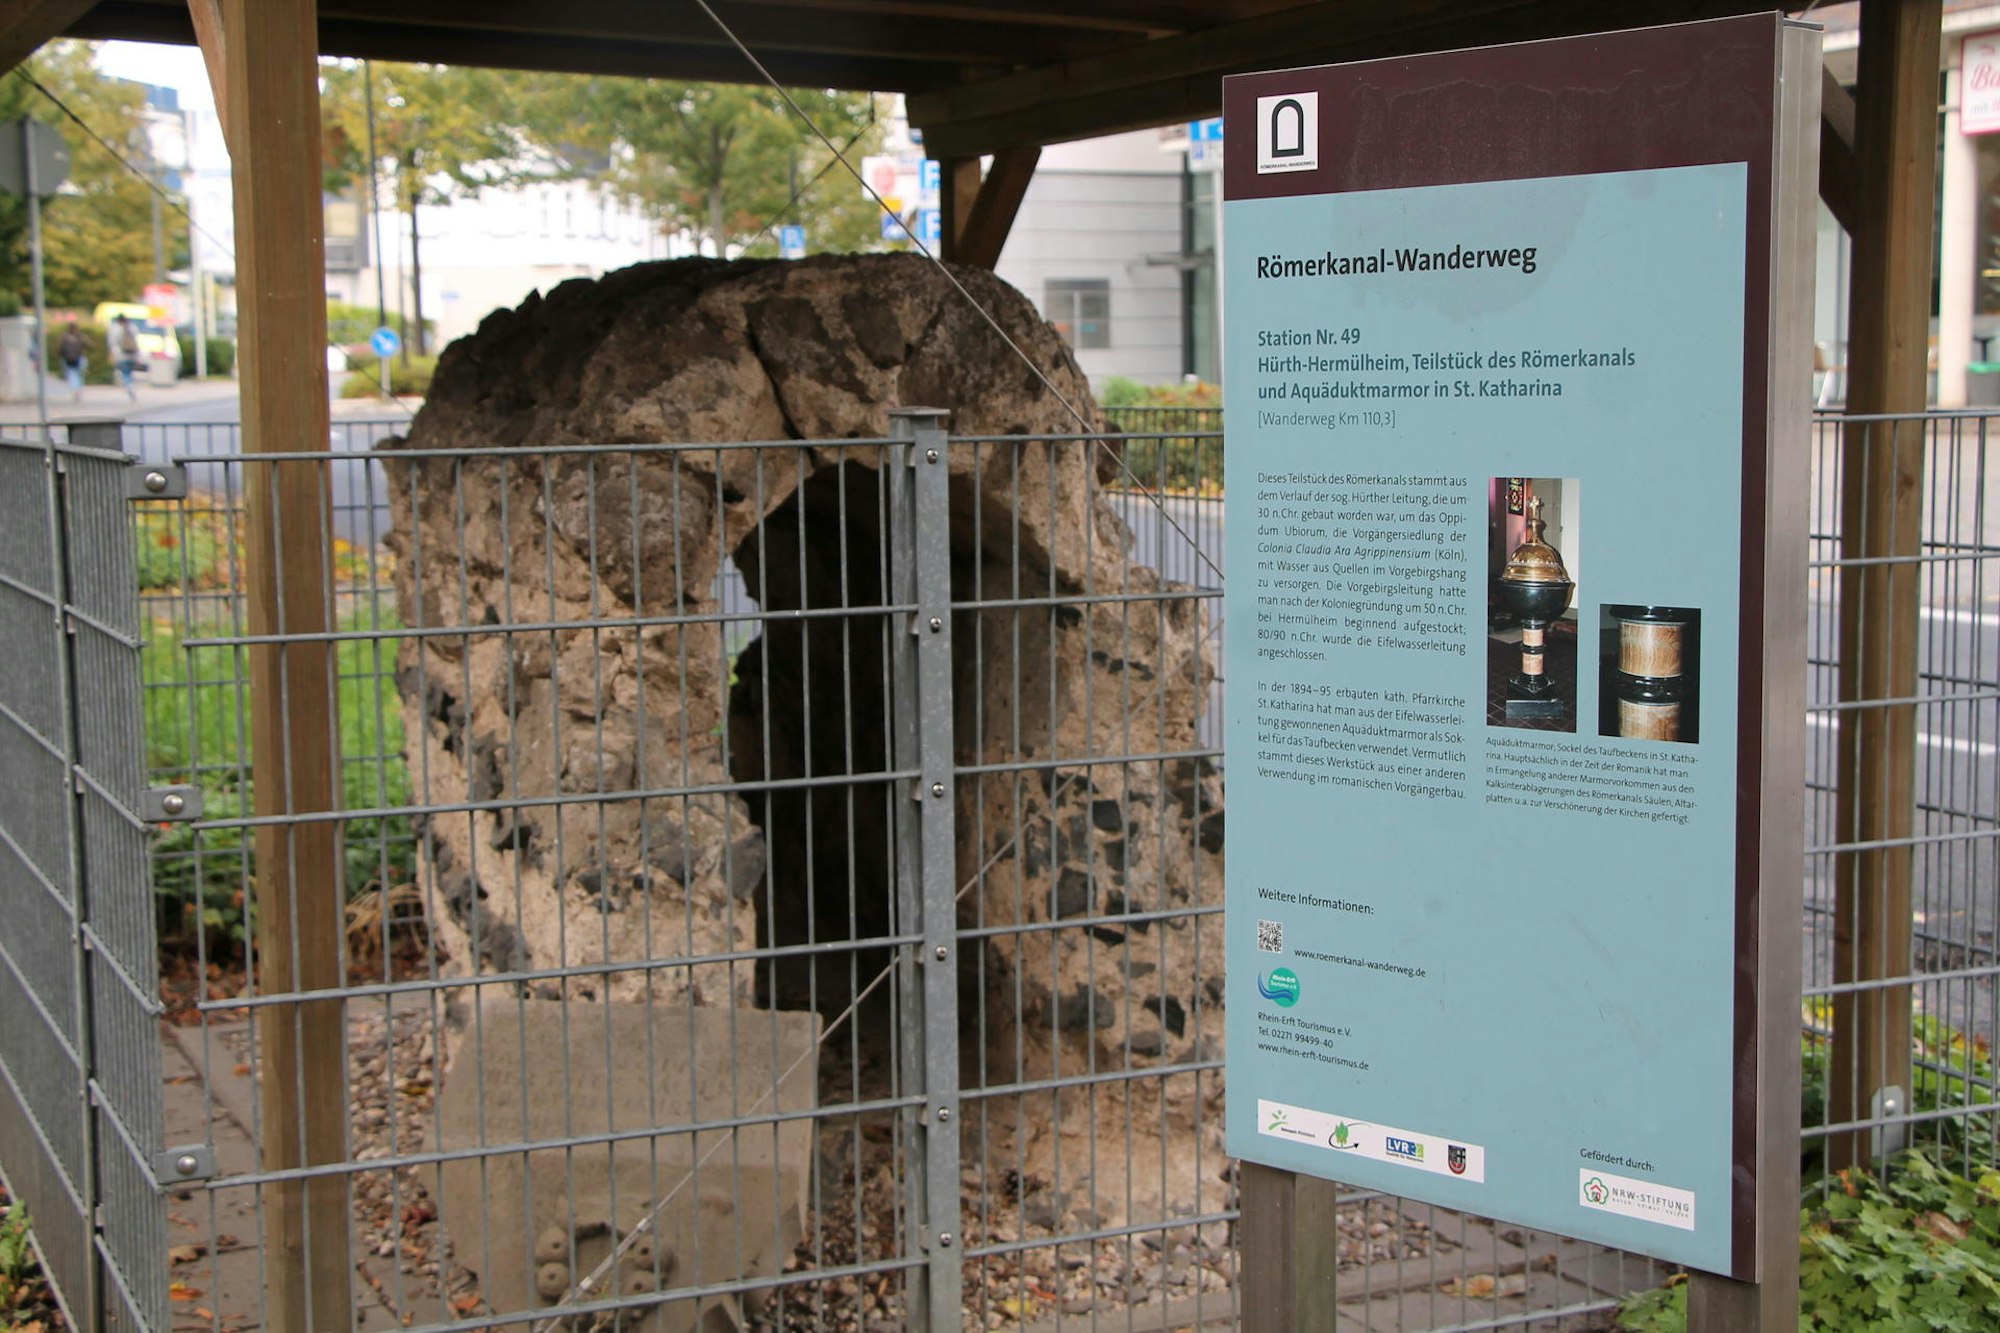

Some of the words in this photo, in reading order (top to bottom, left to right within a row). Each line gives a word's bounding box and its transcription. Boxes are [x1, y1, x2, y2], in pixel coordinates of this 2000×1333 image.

[1257, 243, 1537, 279] Römerkanal-Wanderweg
[1257, 328, 1312, 347] Station
[1316, 328, 1338, 345] Nr.
[1340, 327, 1361, 345] 49
[1258, 352, 1409, 374] Hürth-Hermülheim,
[1411, 350, 1483, 370] Teilstück
[1487, 349, 1517, 369] des
[1521, 346, 1636, 368] Römerkanals
[1258, 381, 1287, 400] und
[1290, 380, 1430, 404] Aquäduktmarmor
[1434, 379, 1449, 398] in
[1453, 380, 1475, 398] St.
[1478, 378, 1562, 397] Katharina
[1257, 410, 1336, 430] [Wanderweg
[1338, 411, 1359, 425] Km
[1362, 409, 1396, 429] 110,3]
[1257, 472, 1287, 484] Dieses
[1287, 471, 1327, 484] Teilstück
[1328, 473, 1345, 485] des
[1345, 473, 1407, 486] Römerkanals
[1408, 475, 1448, 487] stammt
[1448, 477, 1467, 487] aus
[1257, 489, 1278, 501] dem
[1279, 489, 1313, 502] Verlauf
[1313, 490, 1329, 502] der
[1330, 493, 1350, 506] sog.
[1351, 491, 1389, 504] Hürther
[1391, 492, 1431, 508] Leitung,
[1432, 492, 1448, 505] die
[1449, 496, 1467, 505] um
[1258, 507, 1270, 518] 30
[1300, 508, 1334, 523] gebaut
[1336, 509, 1373, 521] worden
[1375, 512, 1396, 523] war,
[1398, 513, 1415, 522] um
[1418, 510, 1436, 523] das
[1438, 511, 1467, 527] Oppi-
[1257, 524, 1279, 536] dum
[1284, 525, 1328, 539] Ubiorum,
[1332, 526, 1348, 538] die
[1352, 527, 1444, 545] Vorgängersiedlung
[1449, 529, 1467, 542] der
[1257, 541, 1293, 554] Colonia
[1295, 543, 1331, 555] Claudia
[1333, 545, 1351, 556] Ara
[1353, 545, 1431, 560] Agrippinensium
[1434, 547, 1467, 563] (Köln),
[1257, 560, 1274, 571] mit
[1276, 560, 1309, 572] Wasser
[1313, 563, 1330, 573] aus
[1332, 562, 1369, 576] Quellen
[1372, 564, 1386, 575] im
[1388, 565, 1467, 583] Vorgebirgshang
[1257, 578, 1269, 588] zu
[1273, 579, 1321, 593] versorgen.
[1326, 579, 1342, 591] Die
[1346, 580, 1434, 599] Vorgebirgsleitung
[1439, 584, 1467, 598] hatte
[1257, 596, 1278, 605] man
[1280, 595, 1303, 607] nach
[1304, 596, 1320, 608] der
[1321, 597, 1403, 616] Koloniegründung
[1405, 604, 1422, 613] um
[1423, 602, 1436, 614] 50
[1257, 611, 1272, 623] bei
[1278, 612, 1338, 626] Hermülheim
[1344, 616, 1397, 632] beginnend
[1257, 628, 1286, 641] 80/90
[1321, 633, 1352, 645] wurde
[1356, 634, 1372, 647] die
[1377, 635, 1466, 656] Eifelwasserleitung
[1257, 647, 1327, 661] angeschlossen.
[1257, 680, 1267, 691] In
[1270, 681, 1286, 693] der
[1335, 686, 1379, 700] erbauten
[1383, 690, 1408, 703] kath.
[1412, 692, 1466, 708] Pfarrkirche
[1316, 702, 1332, 715] hat
[1334, 706, 1356, 716] man
[1357, 708, 1375, 718] aus
[1376, 707, 1393, 720] der
[1395, 709, 1465, 726] Eifelwasserlei-
[1257, 714, 1280, 730] tung
[1280, 718, 1341, 732] gewonnenen
[1341, 722, 1428, 740] Aquäduktmarmor
[1428, 730, 1443, 742] als
[1444, 731, 1465, 744] Sok-
[1257, 731, 1271, 743] kel
[1271, 732, 1286, 744] für
[1286, 734, 1303, 747] das
[1303, 735, 1356, 752] Taufbecken
[1357, 743, 1411, 757] verwendet.
[1411, 746, 1466, 762] Vermutlich
[1556, 742, 1582, 754] Sockel
[1582, 744, 1598, 755] des
[1597, 746, 1648, 760] Taufbeckens
[1670, 752, 1699, 764] Katha-
[1257, 749, 1293, 763] stammt
[1295, 752, 1325, 766] dieses
[1326, 755, 1375, 771] Werkstück
[1377, 763, 1395, 773] aus
[1397, 765, 1422, 776] einer
[1424, 766, 1466, 780] anderen
[1503, 752, 1559, 765] Hauptsächlich
[1569, 758, 1583, 768] der
[1584, 759, 1600, 770] Zeit
[1600, 761, 1615, 771] der
[1616, 762, 1652, 775] Romanik
[1652, 765, 1667, 777] hat
[1669, 769, 1689, 778] man
[1257, 766, 1316, 786] Verwendung
[1317, 775, 1330, 784] im
[1331, 776, 1393, 791] romanischen
[1394, 780, 1466, 799] Vorgängerbau.
[1494, 765, 1547, 782] Ermangelung
[1547, 771, 1578, 782] anderer
[1578, 773, 1661, 790] Marmorvorkommen
[1661, 783, 1677, 792] aus
[1677, 783, 1695, 794] den
[1485, 779, 1575, 798] Kalksinterablagerungen
[1576, 787, 1591, 798] des
[1591, 789, 1643, 804] Römerkanals
[1674, 798, 1698, 809] Altar-
[1485, 792, 1513, 804] platten
[1543, 799, 1603, 816] Verschönerung
[1603, 805, 1618, 815] der
[1618, 807, 1650, 819] Kirchen
[1257, 887, 1297, 904] Weitere
[1298, 892, 1374, 915] Informationen:
[1293, 949, 1426, 978] www.roemerkanal-wanderweg.de
[1257, 1011, 1296, 1027] Rhein-Erft
[1296, 1017, 1336, 1034] Tourismus
[1257, 1025, 1270, 1036] Tel.
[1271, 1028, 1293, 1041] 02271
[1294, 1032, 1334, 1049] 99499-40
[1257, 1042, 1369, 1071] www.rhein-erft-tourismus.de
[1387, 1138, 1409, 1154] LVR
[1579, 1147, 1624, 1166] Gefördert
[1625, 1157, 1655, 1173] durch:
[1612, 1187, 1690, 1213] NRW-STIFTUNG
